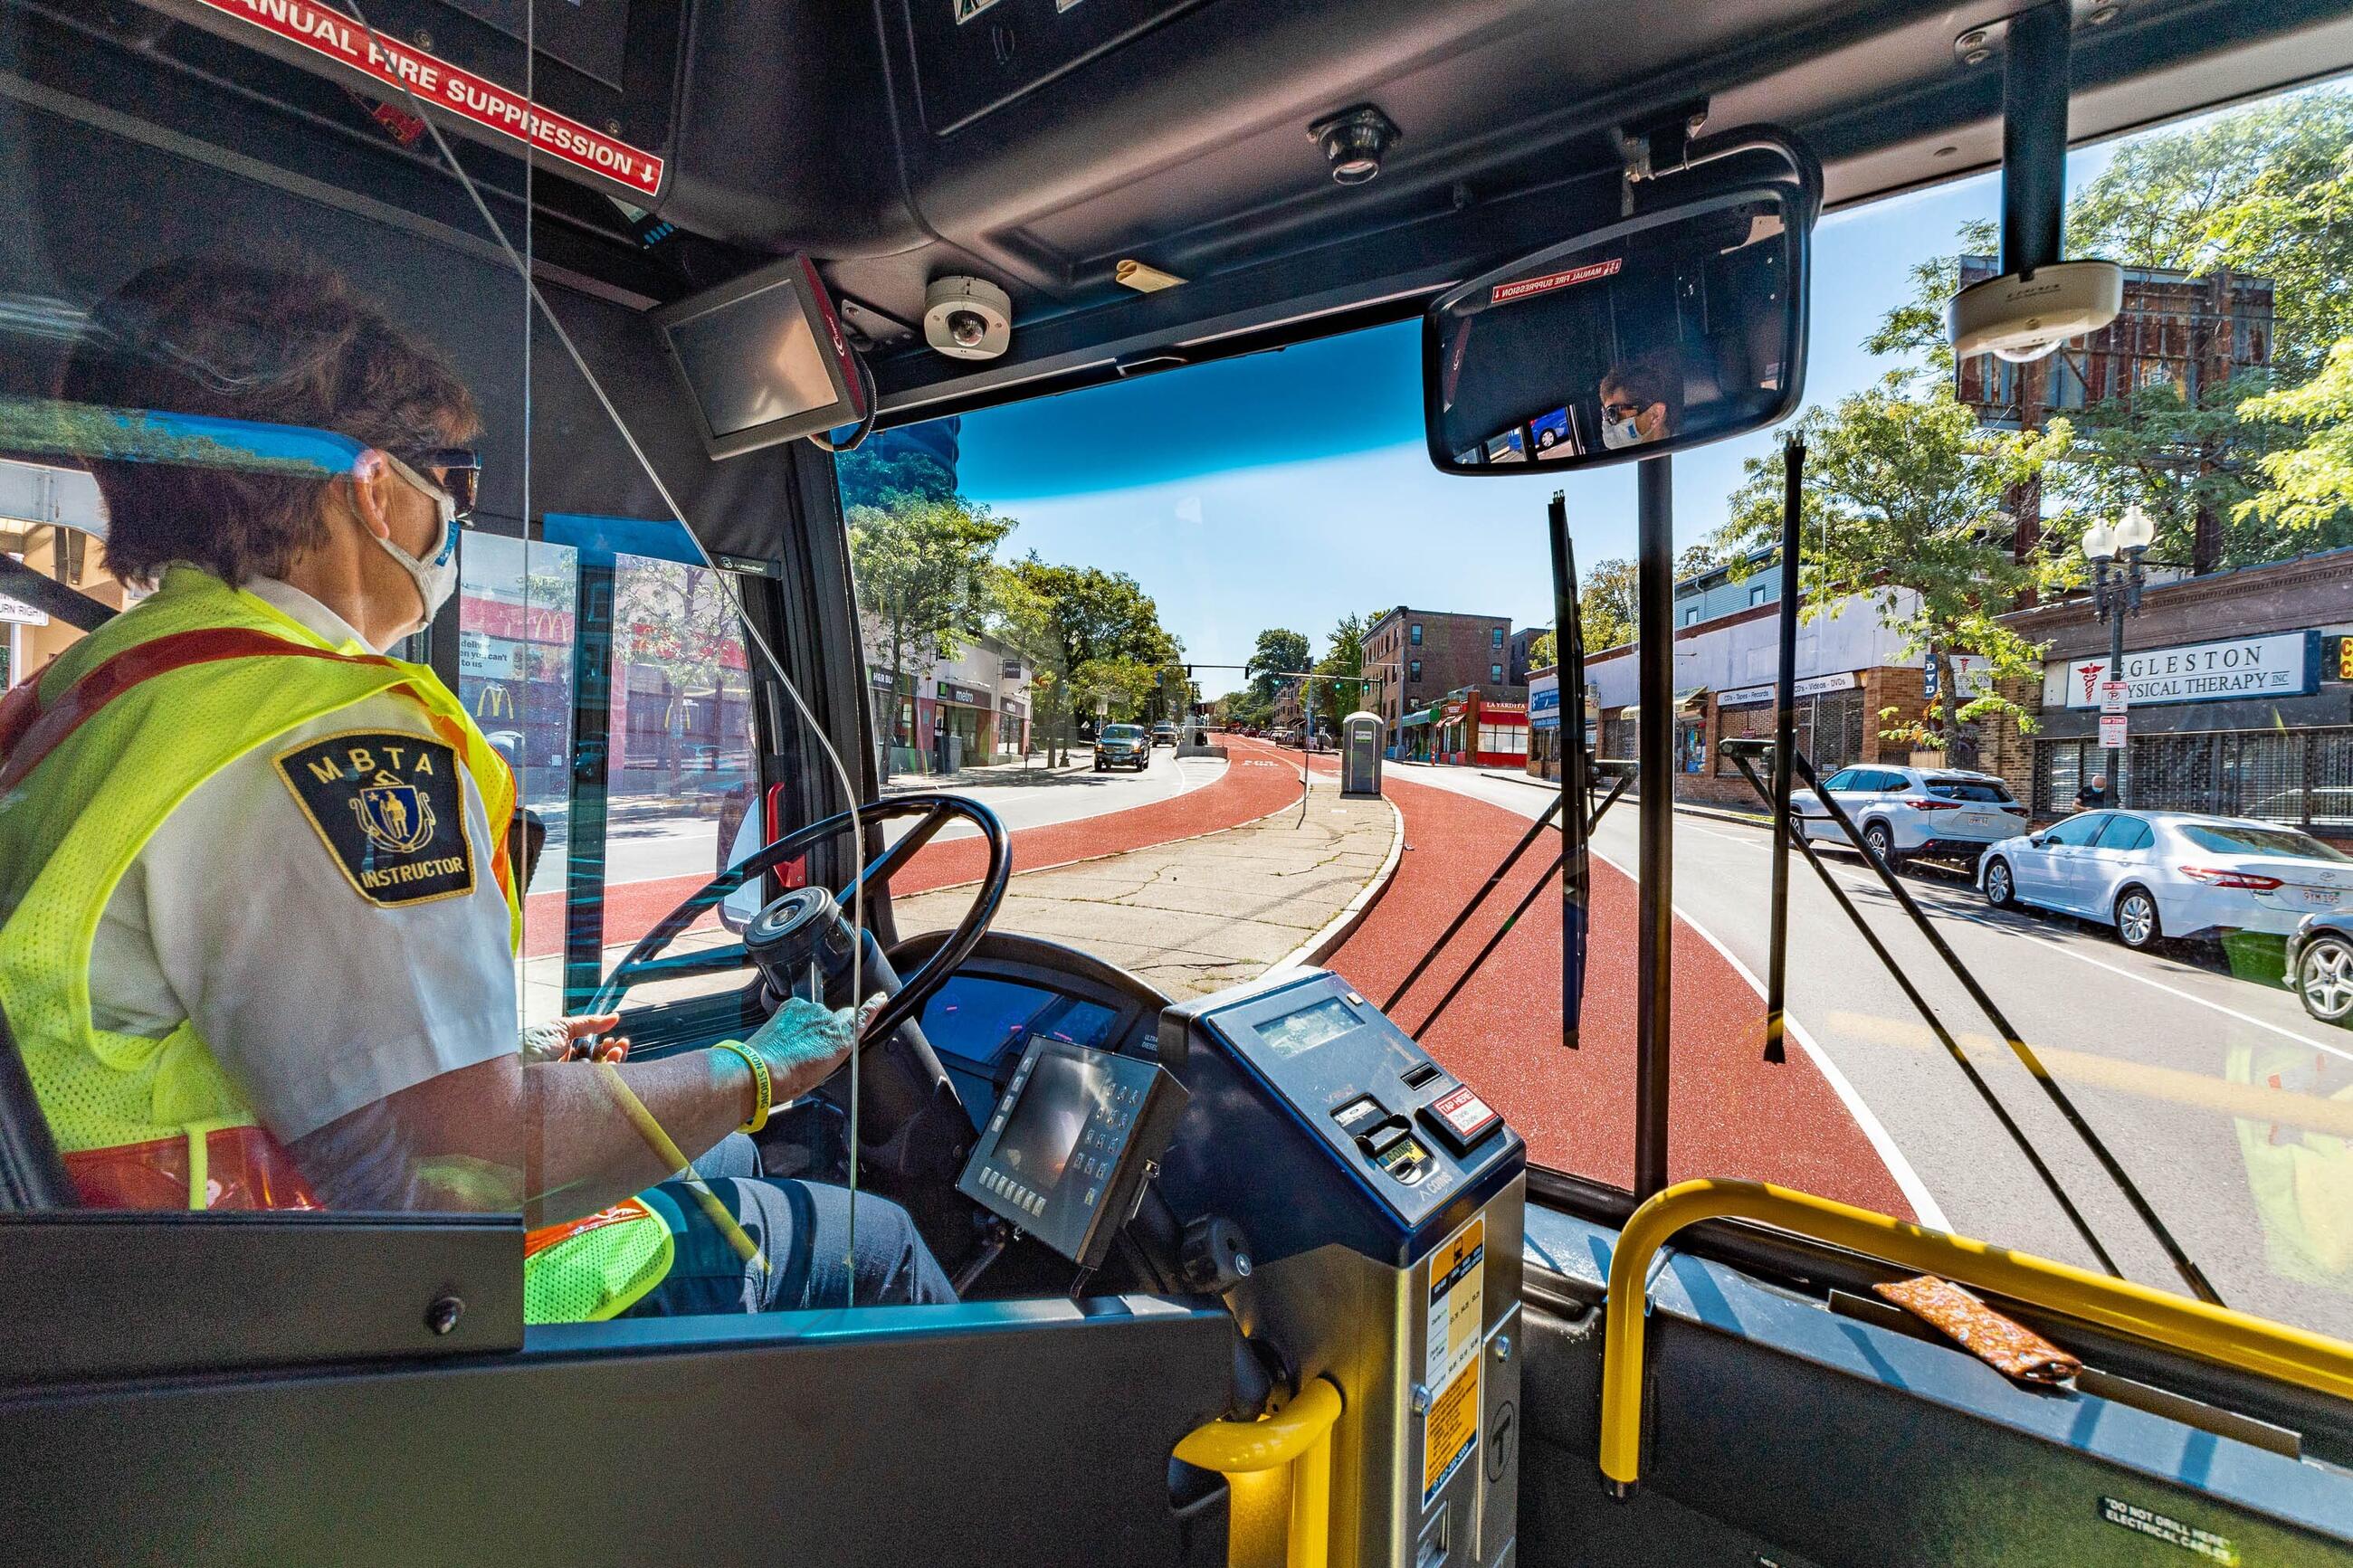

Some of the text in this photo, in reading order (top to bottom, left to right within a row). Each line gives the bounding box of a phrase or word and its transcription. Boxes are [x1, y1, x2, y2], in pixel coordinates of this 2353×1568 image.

[368, 43, 439, 91] FIRE
[446, 79, 634, 176] SUPPRESSION
[488, 653, 508, 661] can't
[1809, 682, 1826, 690] Videos
[2186, 671, 2269, 694] THERAPY
[2272, 674, 2288, 684] INC
[956, 689, 974, 703] metro
[307, 746, 434, 784] MBTA
[360, 857, 465, 889] INSTRUCTOR
[737, 1044, 769, 1109] BOSTON STRONG
[1440, 1090, 1475, 1114] TAP HERE
[1386, 1141, 1415, 1163] COINS
[1426, 1171, 1453, 1194] COINS
[2105, 1509, 2178, 1544] ELECTRICAL
[2129, 1506, 2153, 1523] NOT
[2155, 1515, 2190, 1536] DRILL
